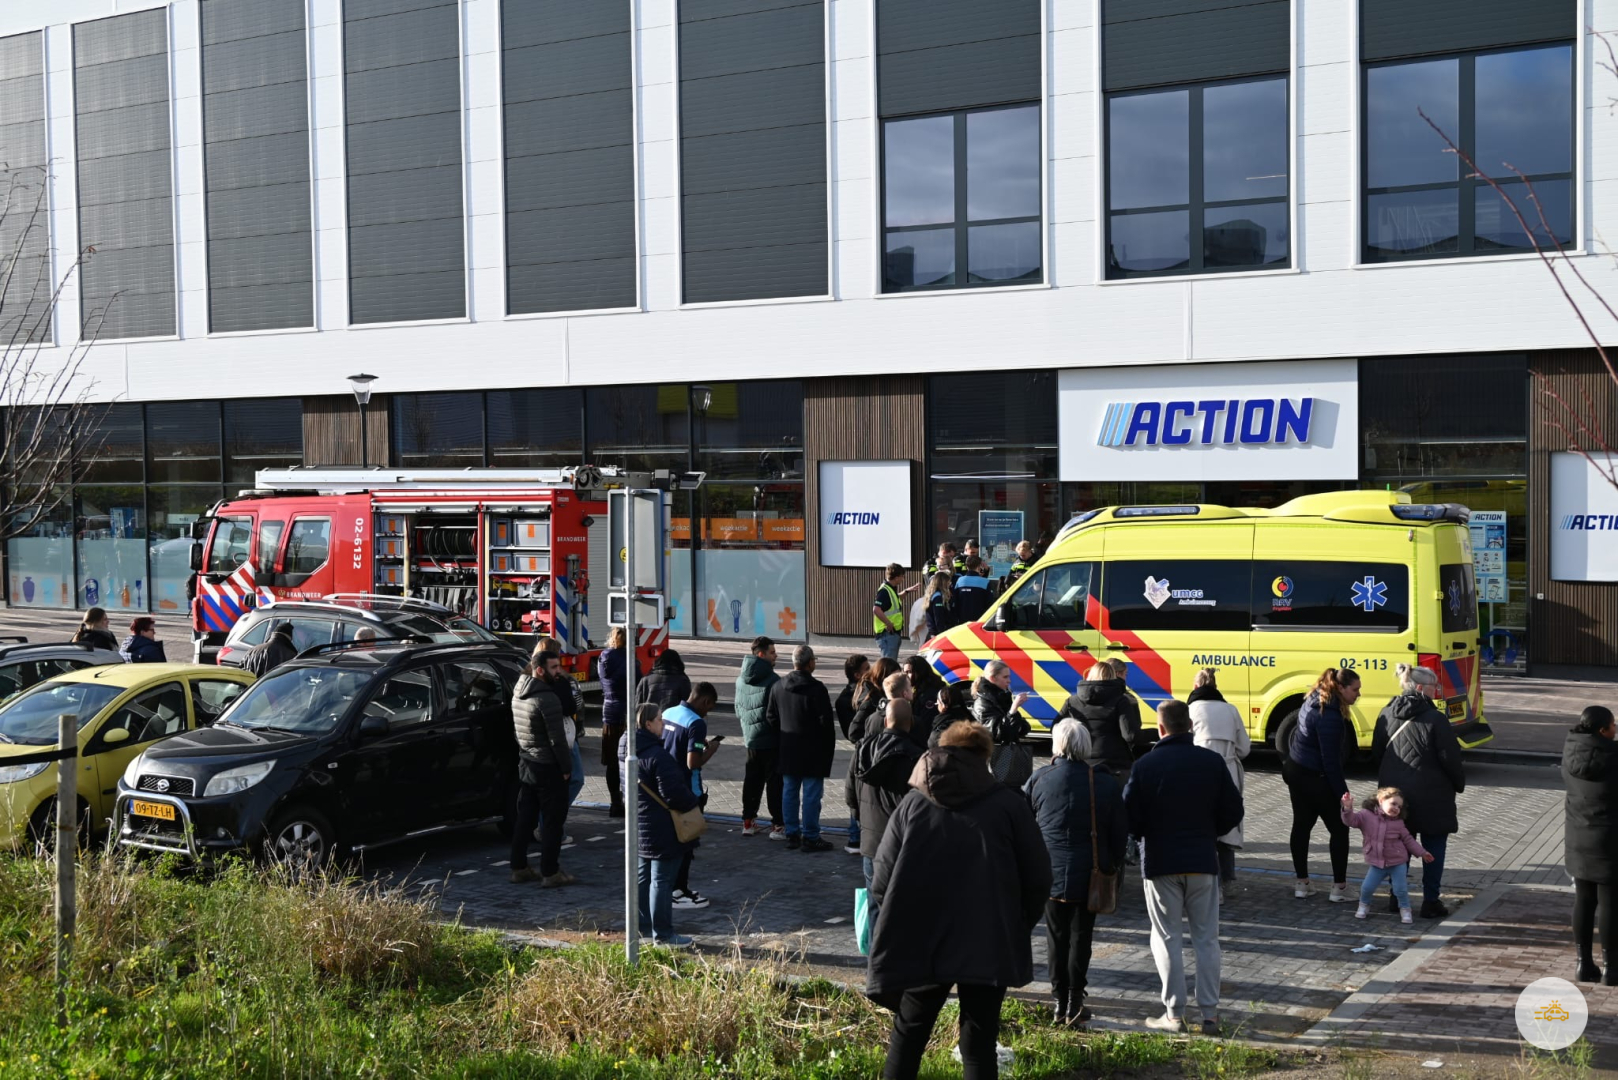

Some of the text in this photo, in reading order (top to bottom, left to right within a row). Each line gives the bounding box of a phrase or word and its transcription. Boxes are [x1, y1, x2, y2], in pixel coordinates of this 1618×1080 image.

[1124, 397, 1313, 445] ACTION
[833, 512, 880, 525] ACTION
[353, 517, 364, 570] 02-6132
[1191, 654, 1276, 667] AMBULANCE
[1340, 657, 1388, 671] 02-113
[136, 803, 172, 818] 09-TZ-LH
